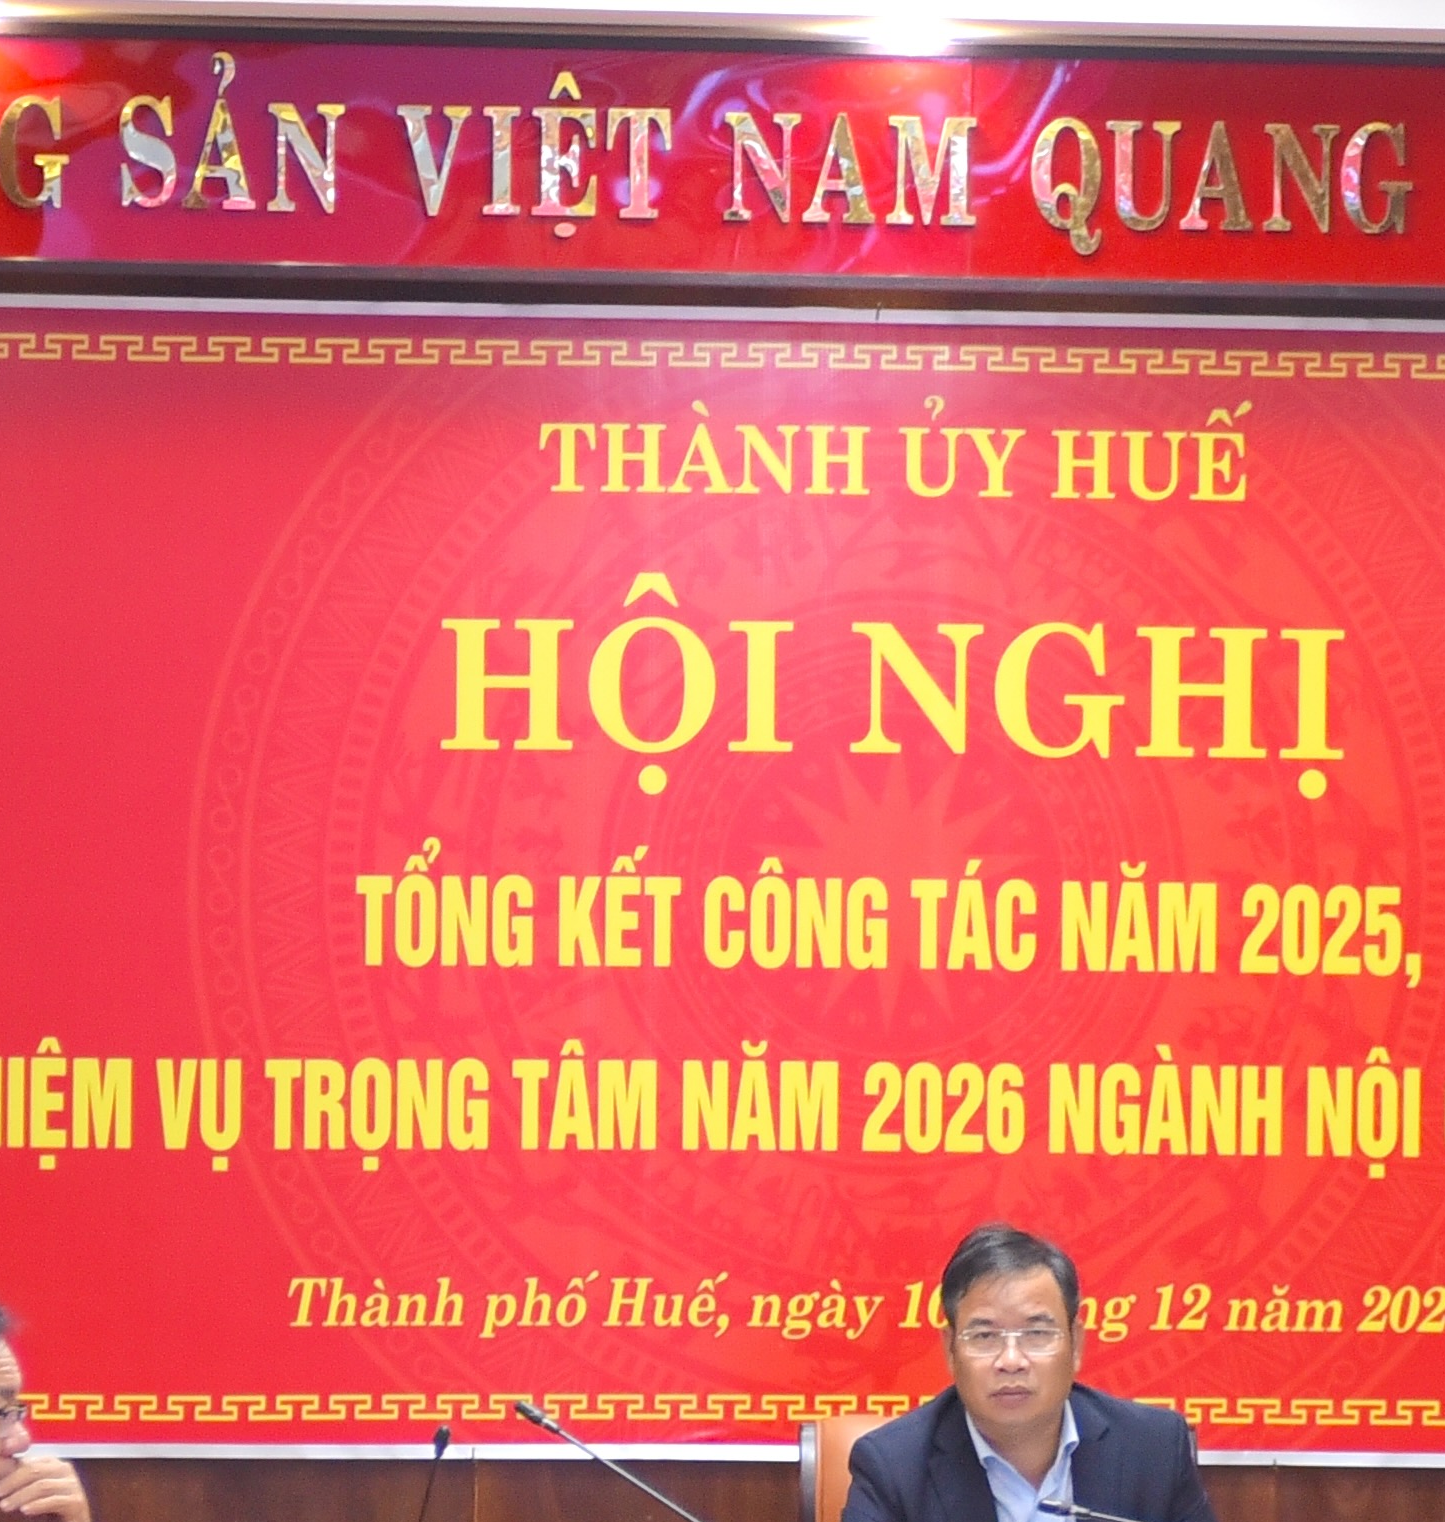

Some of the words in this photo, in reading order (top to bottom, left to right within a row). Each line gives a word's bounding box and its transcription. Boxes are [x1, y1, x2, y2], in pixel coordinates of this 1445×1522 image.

[119, 51, 345, 213] SẢN
[397, 70, 671, 238] VIỆT
[722, 111, 977, 226] NAM
[1030, 117, 1413, 255] QUANG
[540, 400, 871, 495] THÀNH
[899, 395, 1025, 497] ỦY
[1051, 402, 1251, 501] HUẾ
[441, 571, 794, 795] HỘI
[850, 622, 1345, 799] NGHỊ
[356, 837, 533, 967] TỔNG
[559, 846, 681, 967] KẾT
[704, 857, 888, 970] CÔNG
[911, 859, 1036, 971] TÁC
[1061, 862, 1217, 972] NĂM
[1240, 884, 1421, 987] 2025,
[157, 1059, 241, 1171] VỤ
[265, 1058, 489, 1171] TRỌNG
[512, 1039, 657, 1150] TÂM
[683, 1040, 839, 1151] NĂM
[862, 1062, 1025, 1154] 2026
[1049, 1044, 1282, 1156] NGÀNH
[1307, 1047, 1420, 1178] NỘI
[288, 1277, 464, 1327] Thành
[480, 1270, 599, 1338] phố
[602, 1272, 730, 1335] Huế,
[748, 1279, 883, 1340] ngày
[1149, 1283, 1210, 1331] 12
[1224, 1285, 1342, 1332] năm
